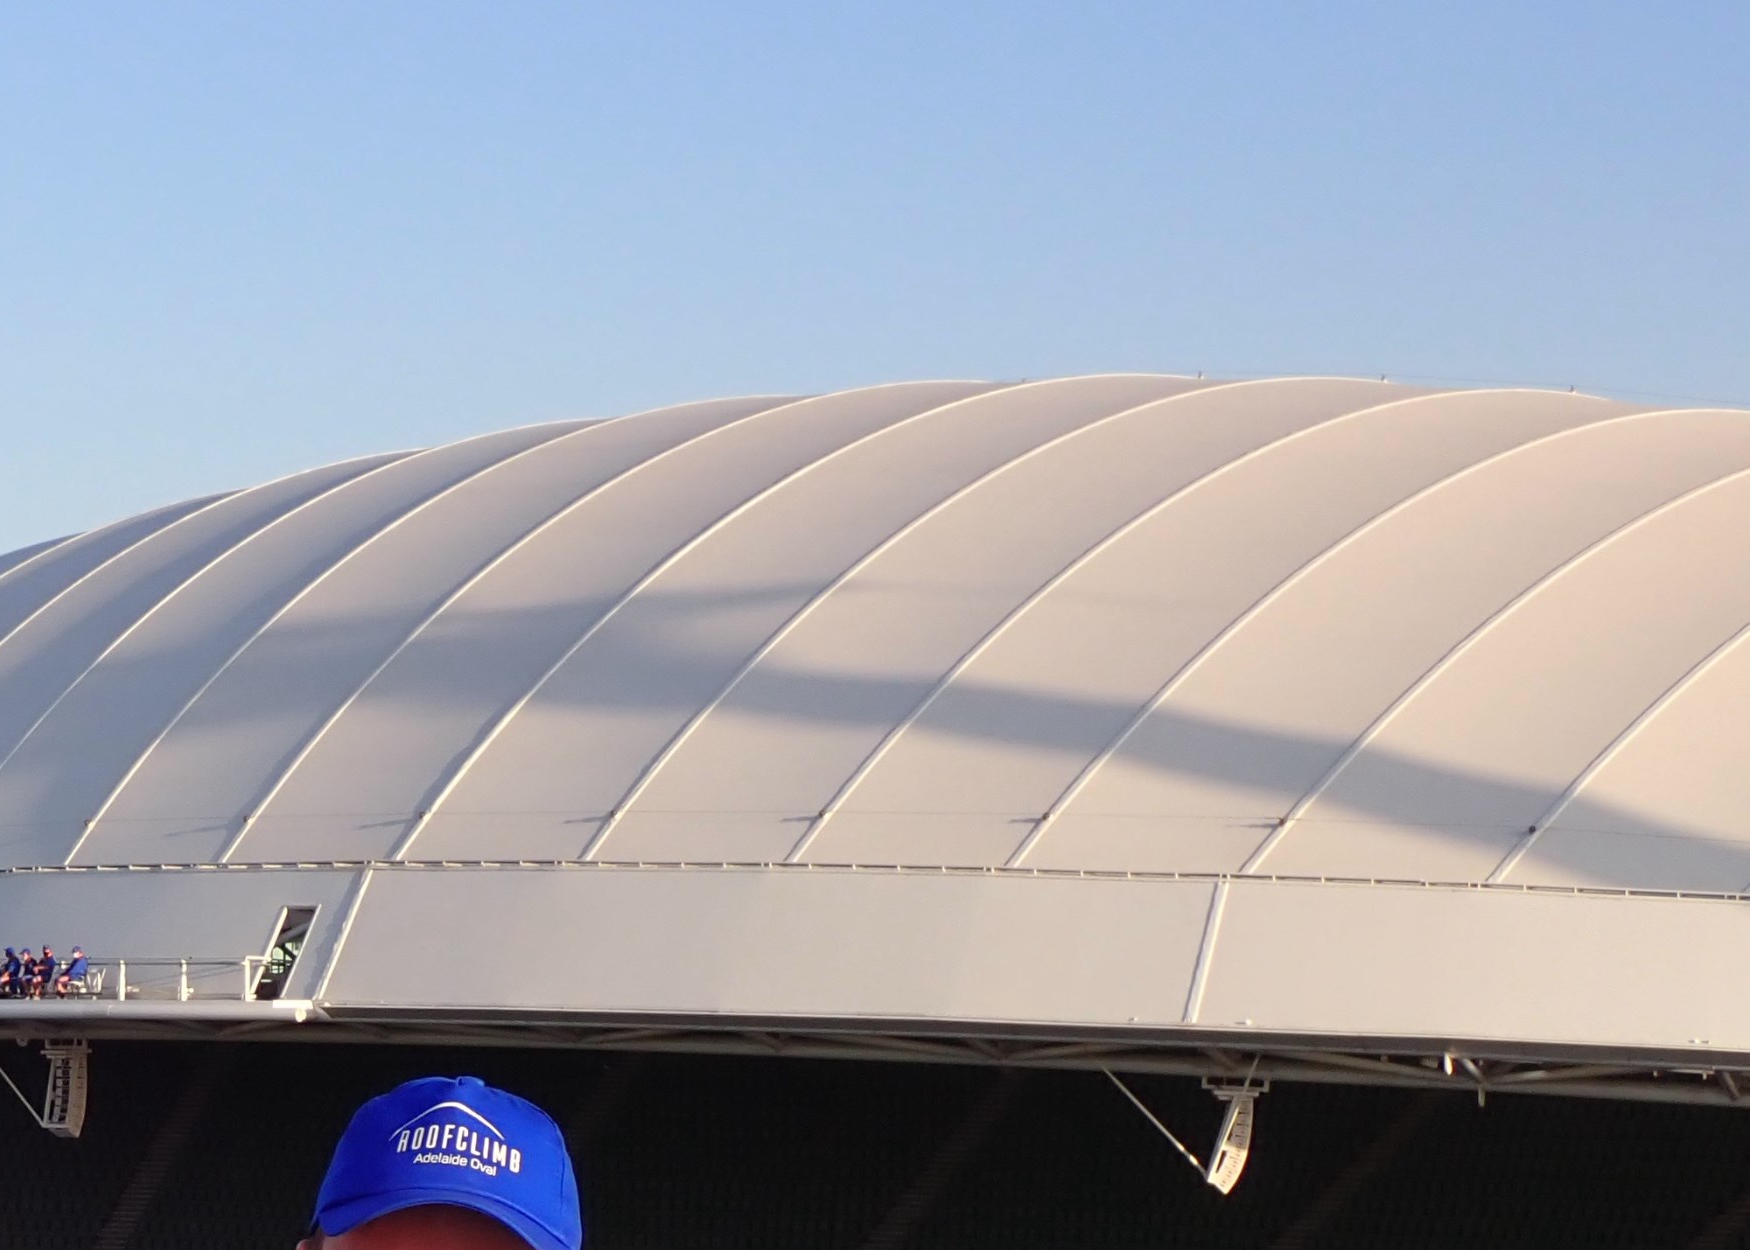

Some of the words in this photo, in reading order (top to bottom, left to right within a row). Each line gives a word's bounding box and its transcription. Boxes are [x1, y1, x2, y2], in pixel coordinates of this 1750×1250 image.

[396, 1124, 521, 1174] ROOFCLIMB
[413, 1152, 468, 1167] Adelaide
[470, 1158, 497, 1176] Oval
